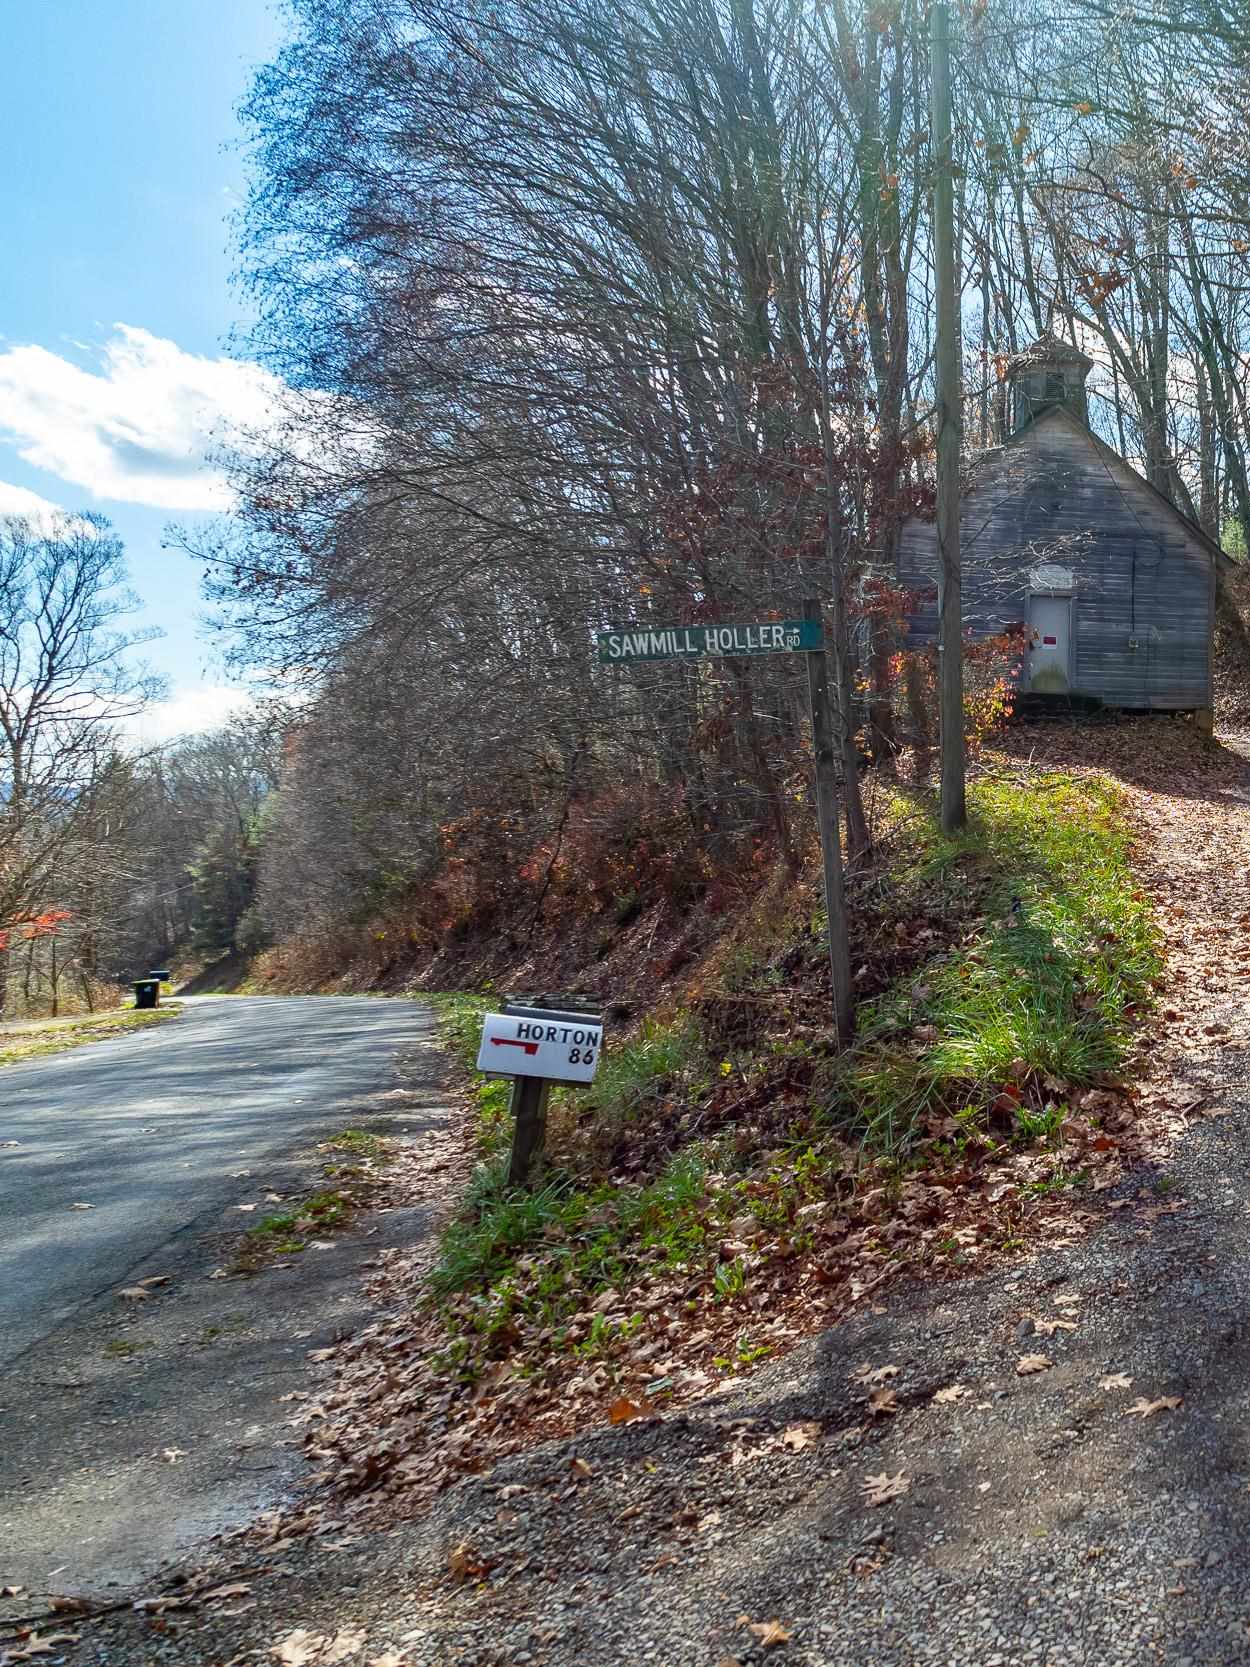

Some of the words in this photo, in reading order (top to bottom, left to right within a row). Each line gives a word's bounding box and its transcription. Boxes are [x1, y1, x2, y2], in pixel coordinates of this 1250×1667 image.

[608, 631, 698, 657] SAWMILL
[704, 626, 785, 652] HOLLER
[786, 635, 800, 647] RD
[517, 1023, 599, 1047] HORTON
[568, 1048, 594, 1065] 86
